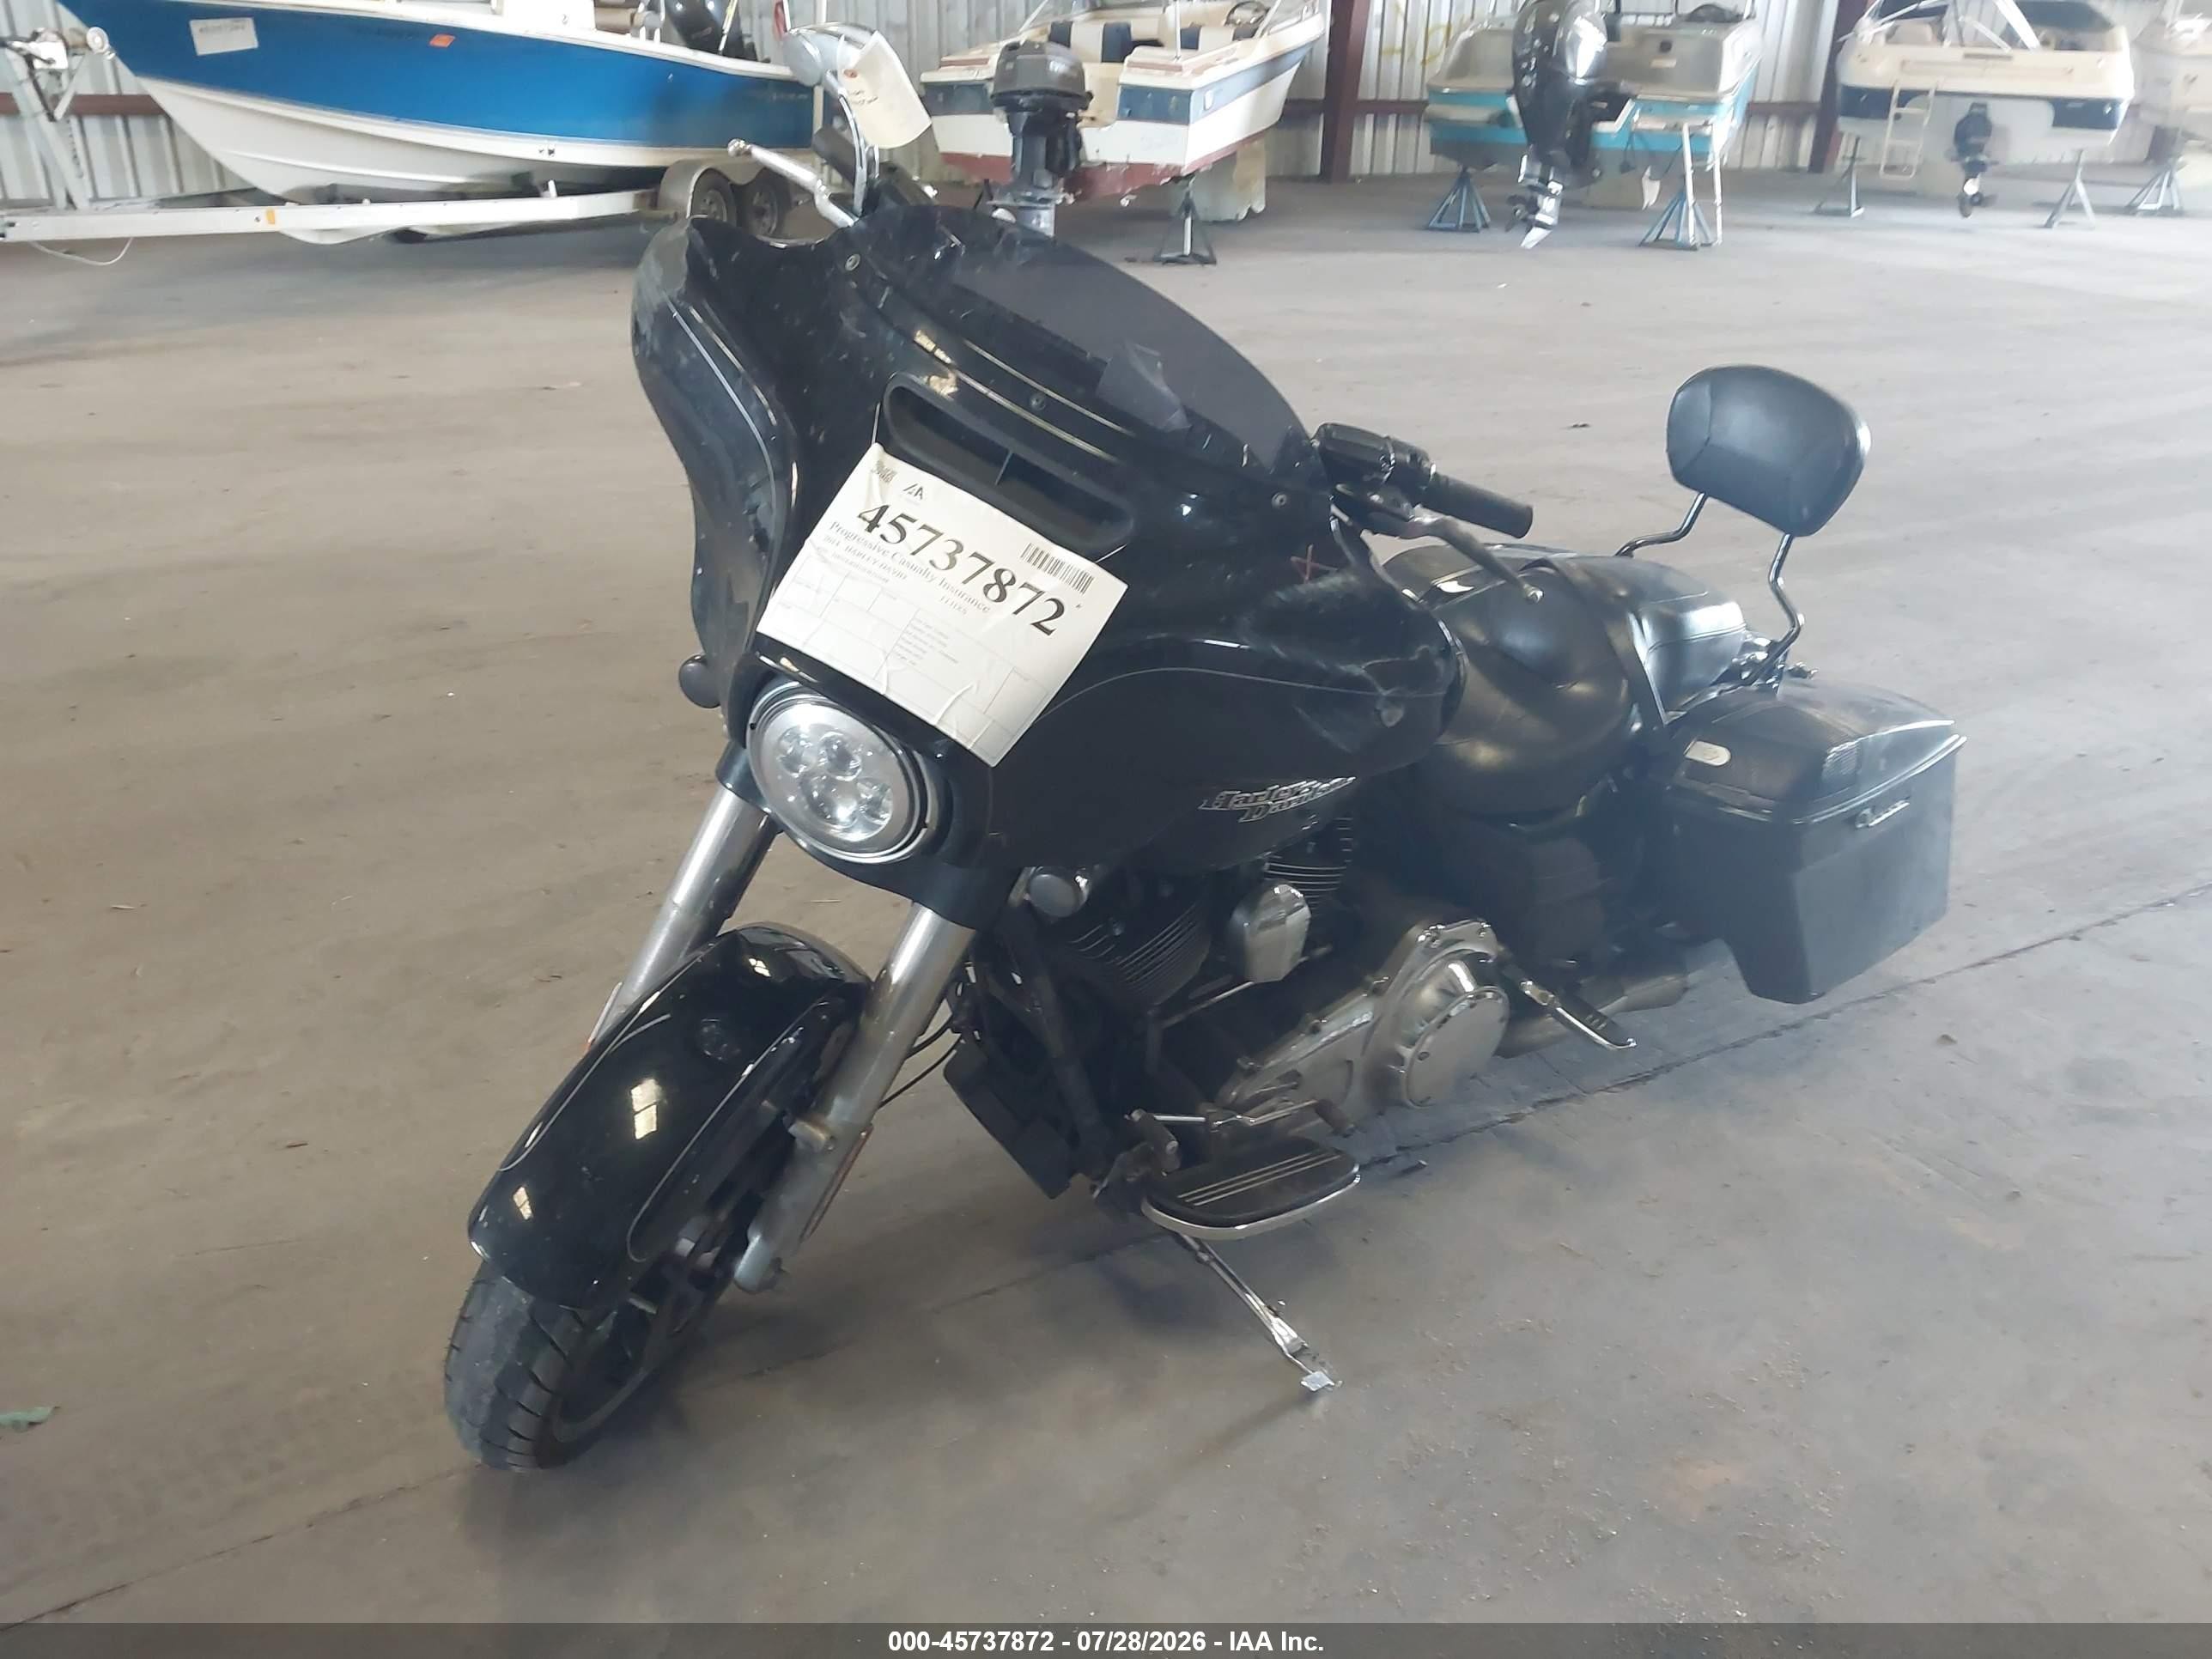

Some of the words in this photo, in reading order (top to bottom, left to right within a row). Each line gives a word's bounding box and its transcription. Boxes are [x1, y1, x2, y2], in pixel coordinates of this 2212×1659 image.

[830, 520, 890, 556] Progressive
[891, 551, 935, 584] Casualty
[939, 577, 991, 613] Insurance
[857, 504, 1066, 635] 45737872
